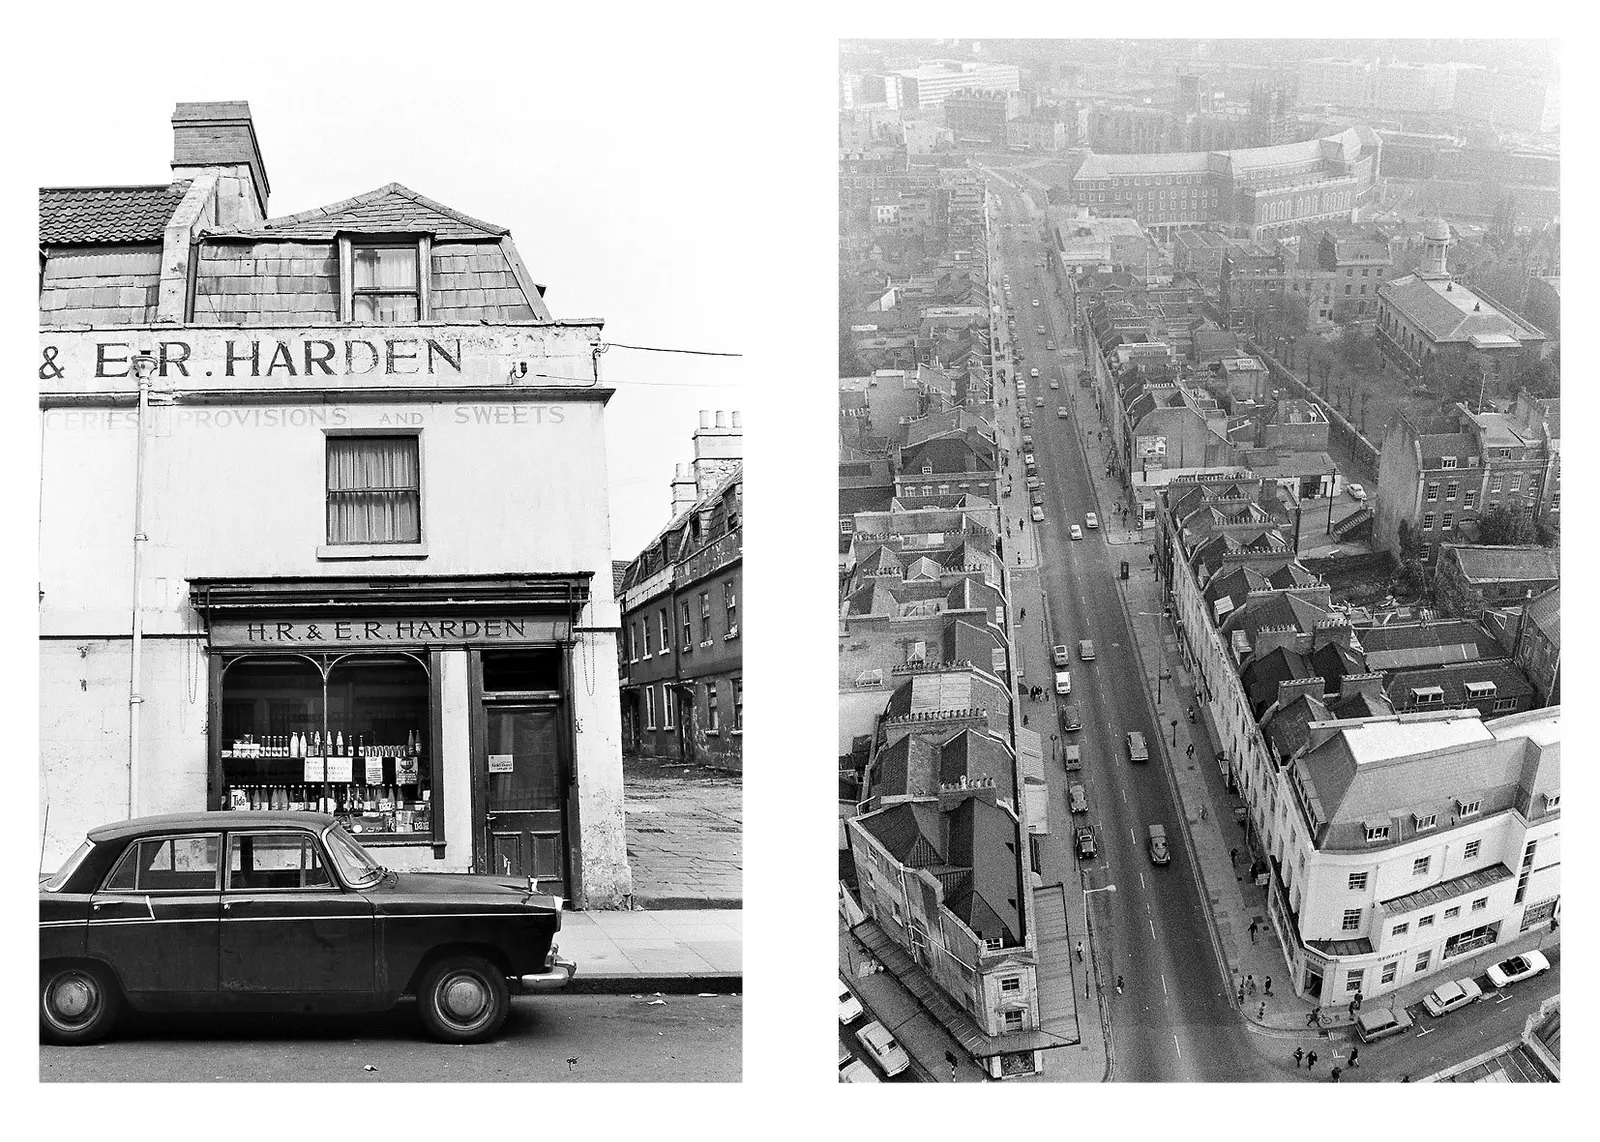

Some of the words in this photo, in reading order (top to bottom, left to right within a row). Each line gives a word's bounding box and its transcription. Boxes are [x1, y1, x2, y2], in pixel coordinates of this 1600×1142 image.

[39, 345, 65, 379] &
[224, 338, 462, 377] HARDEN
[177, 406, 348, 430] PROVISIONS
[379, 412, 424, 425] AND
[454, 405, 565, 425] SWEETS
[306, 624, 325, 640] &
